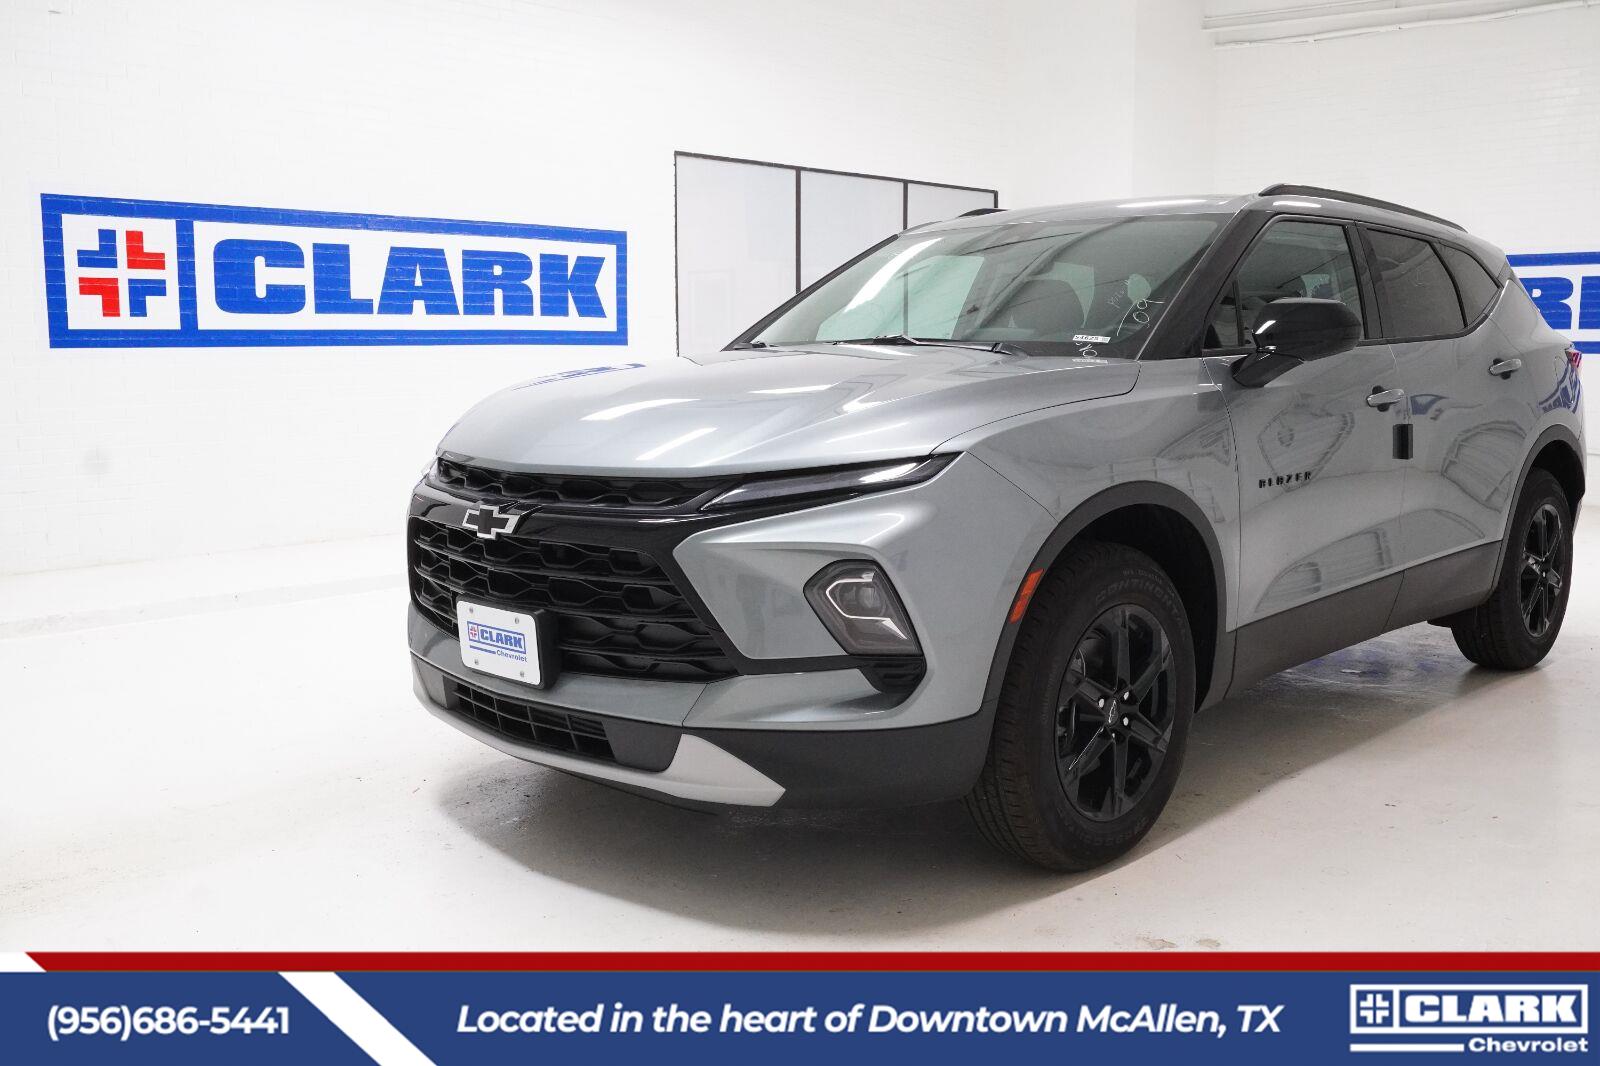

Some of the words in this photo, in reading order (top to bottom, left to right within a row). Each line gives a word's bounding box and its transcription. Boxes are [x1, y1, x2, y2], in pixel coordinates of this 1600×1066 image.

[213, 238, 608, 319] CLARK
[1258, 471, 1312, 489] BLAZER
[480, 628, 523, 649] CLARK
[496, 649, 527, 663] Chevrolet
